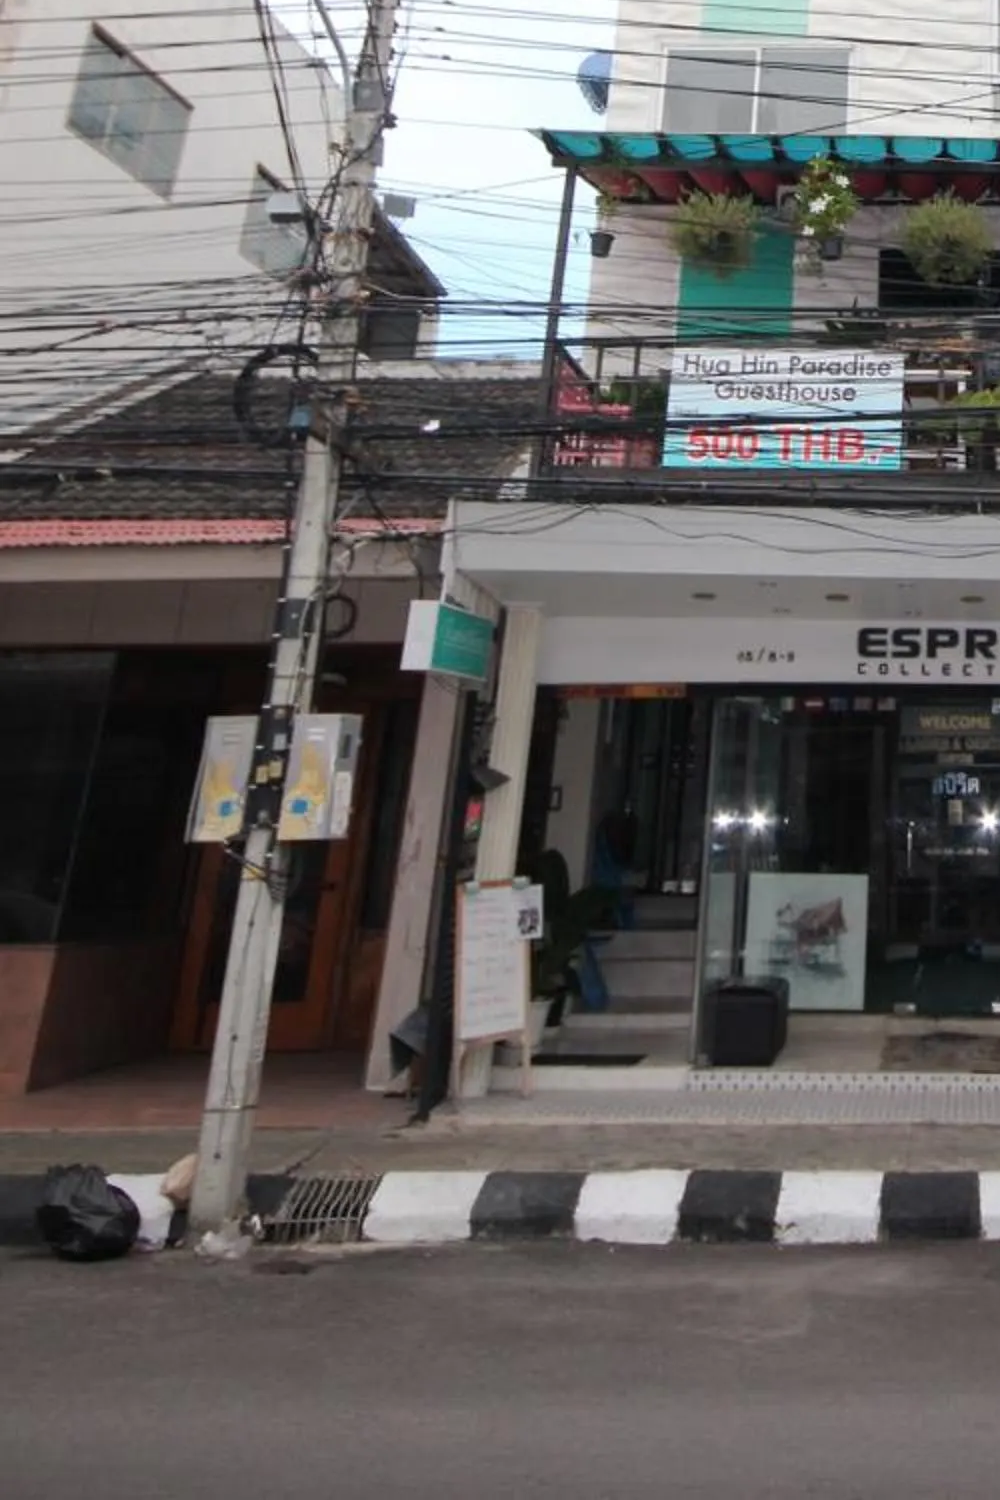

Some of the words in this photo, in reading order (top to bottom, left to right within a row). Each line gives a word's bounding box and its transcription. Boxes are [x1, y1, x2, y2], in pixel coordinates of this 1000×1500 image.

[741, 354, 779, 375] Hin
[789, 354, 892, 377] Paradise
[714, 379, 857, 402] Guesthouse
[687, 425, 760, 461] 500
[919, 714, 991, 730] WELCOME
